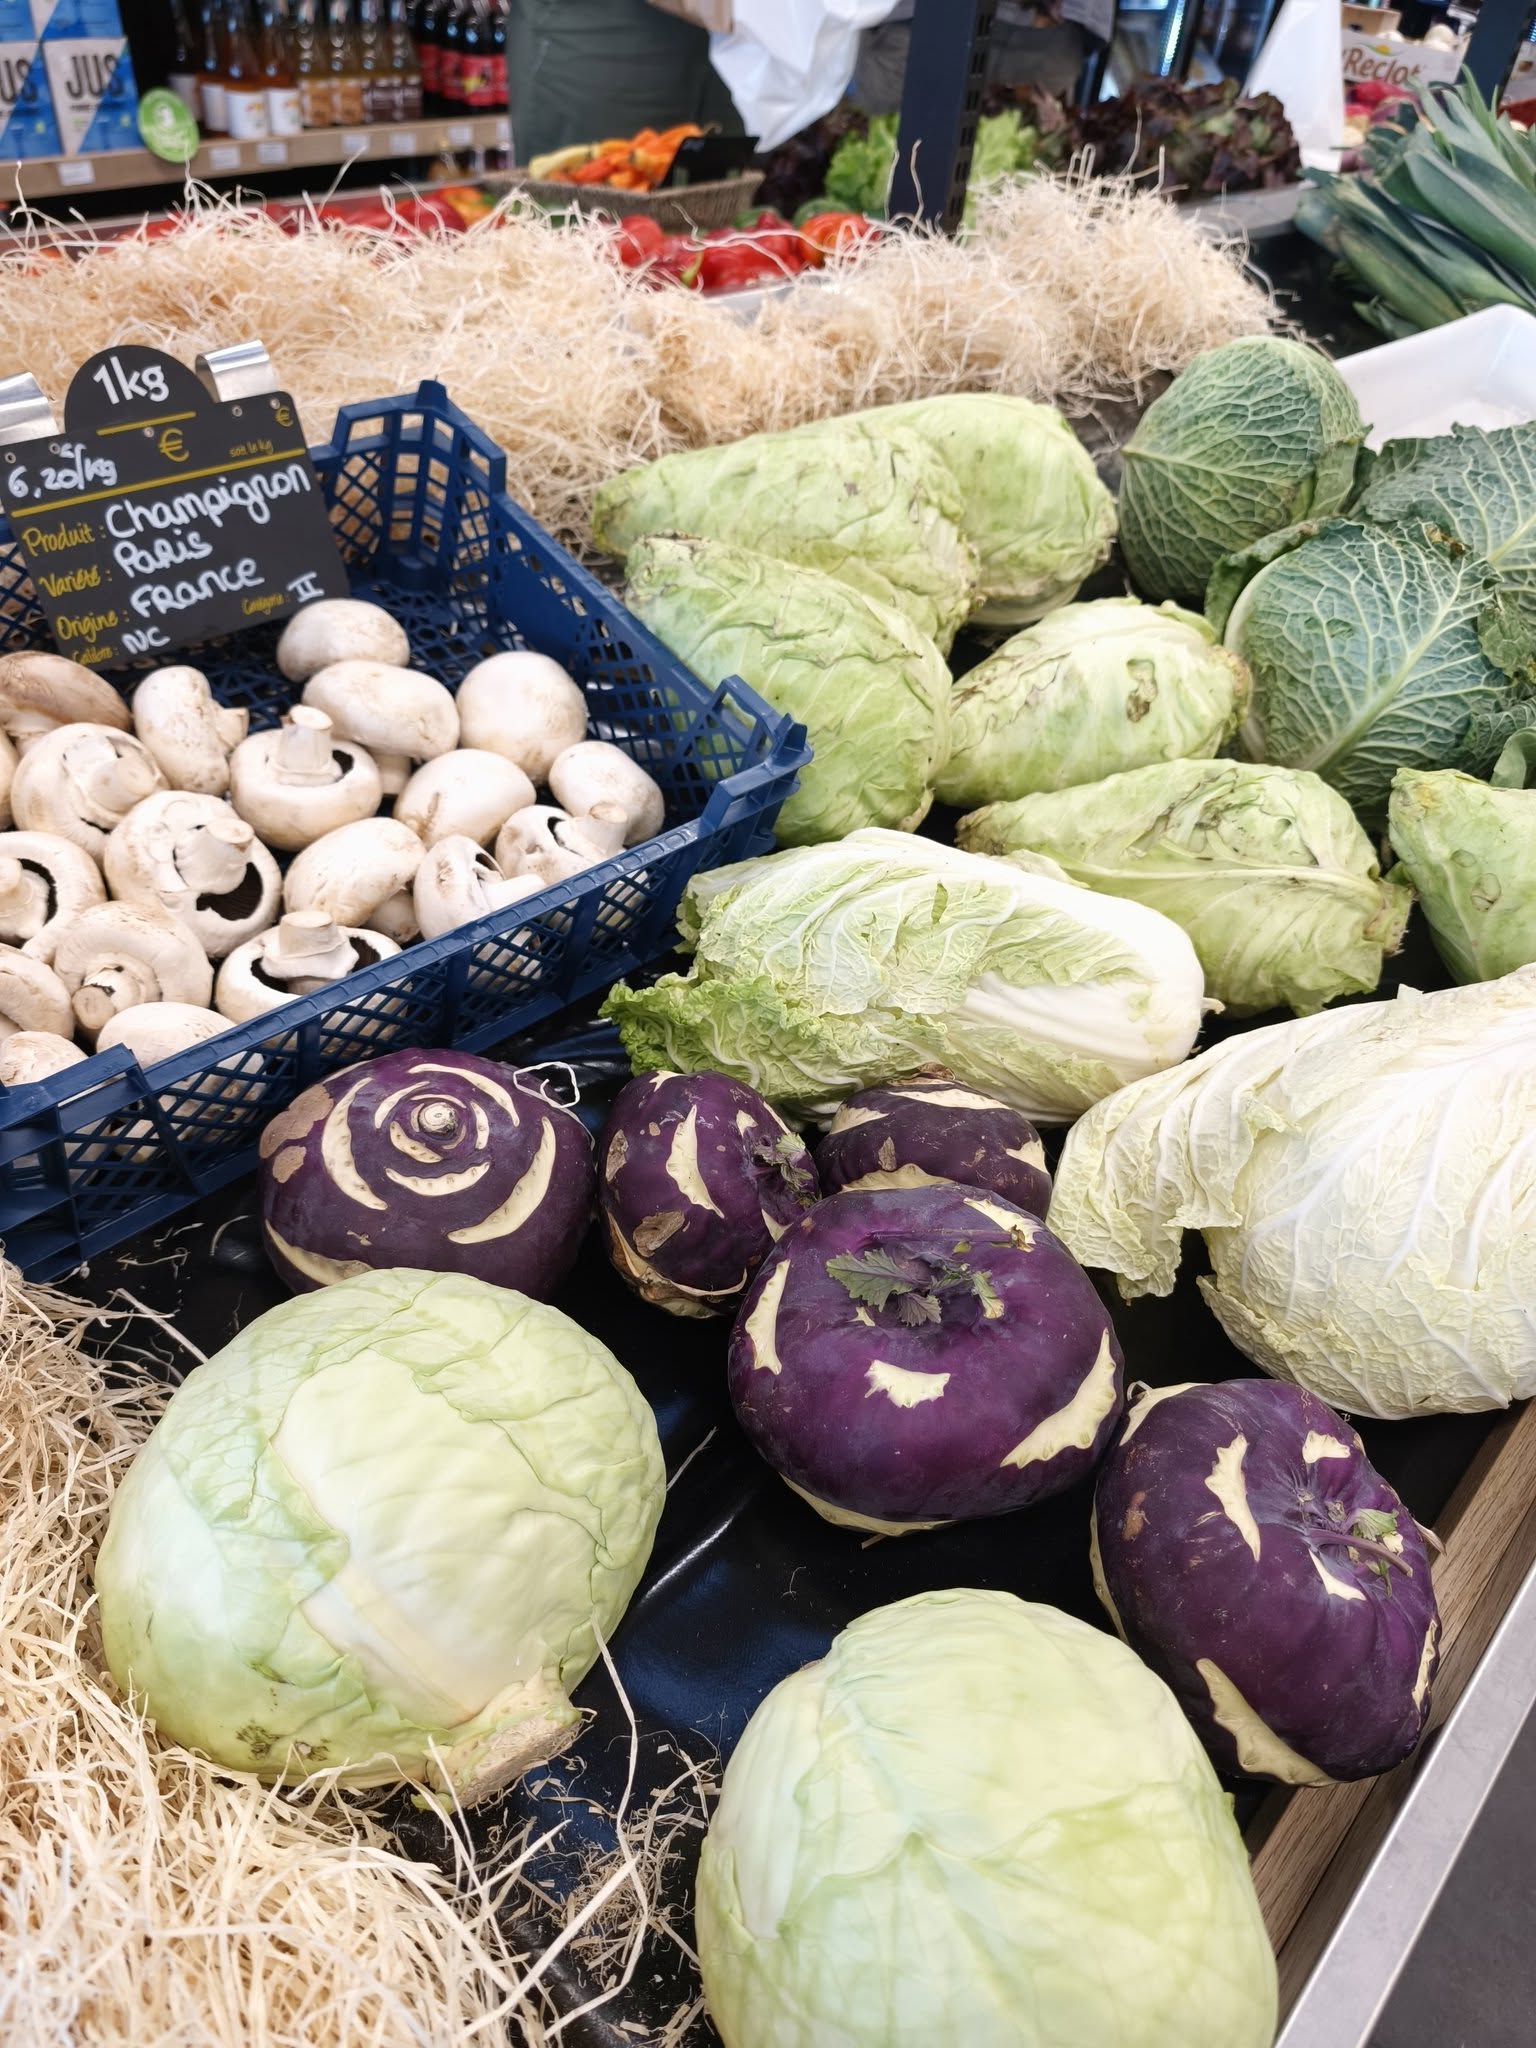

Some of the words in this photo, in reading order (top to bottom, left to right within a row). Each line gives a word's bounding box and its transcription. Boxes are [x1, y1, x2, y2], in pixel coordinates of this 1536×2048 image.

[65, 54, 125, 98] JUS
[93, 356, 169, 405] 1kg
[157, 427, 189, 462] €
[105, 464, 311, 539] Champignon
[114, 529, 212, 578] Paris
[286, 571, 325, 603] II
[56, 610, 118, 643] Origine
[121, 625, 170, 655] NC
